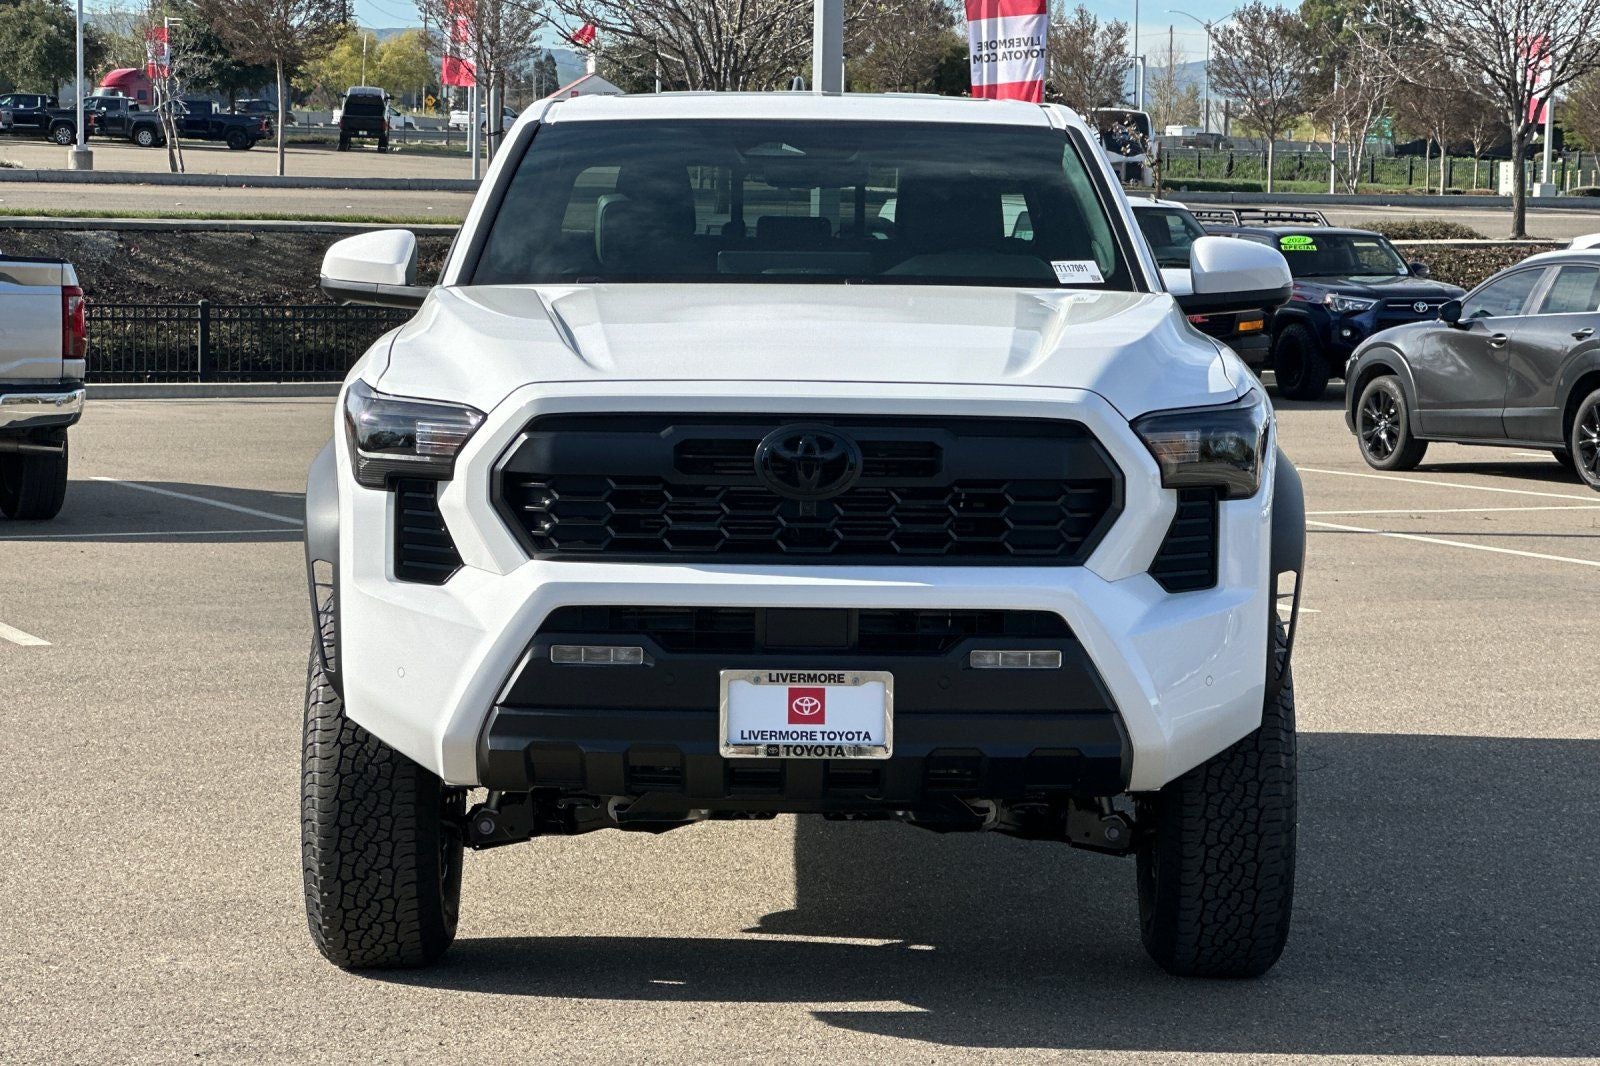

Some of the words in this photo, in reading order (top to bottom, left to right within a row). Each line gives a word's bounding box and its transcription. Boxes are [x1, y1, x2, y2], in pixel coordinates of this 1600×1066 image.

[768, 673, 845, 684] LIVERMORE
[740, 730, 818, 741] LIVERMORE
[819, 730, 872, 741] TOYOTA
[783, 744, 846, 757] TOYOTA
